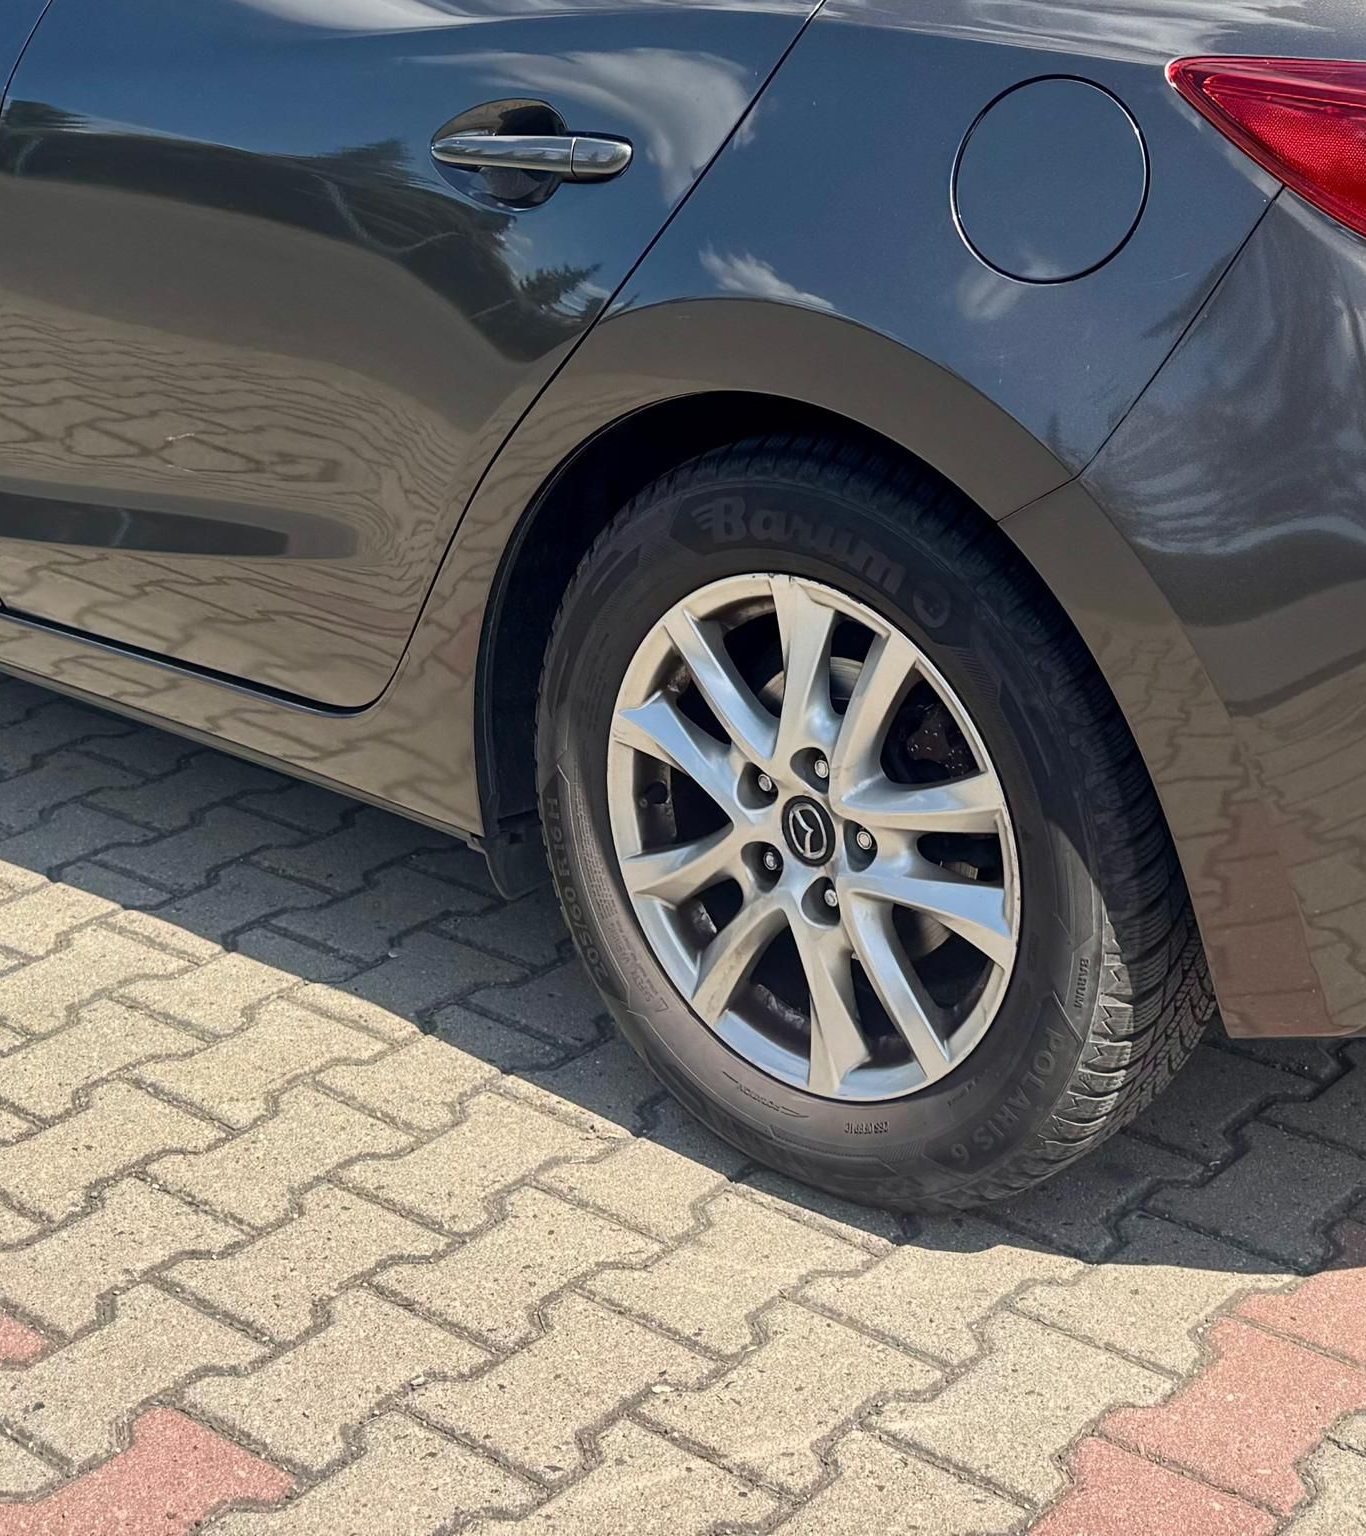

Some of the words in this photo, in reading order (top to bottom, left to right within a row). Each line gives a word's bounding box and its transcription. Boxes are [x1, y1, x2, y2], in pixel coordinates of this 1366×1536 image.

[692, 495, 907, 595] Barum
[1074, 958, 1090, 1009] BARUM
[972, 1026, 1066, 1151] POLARIS
